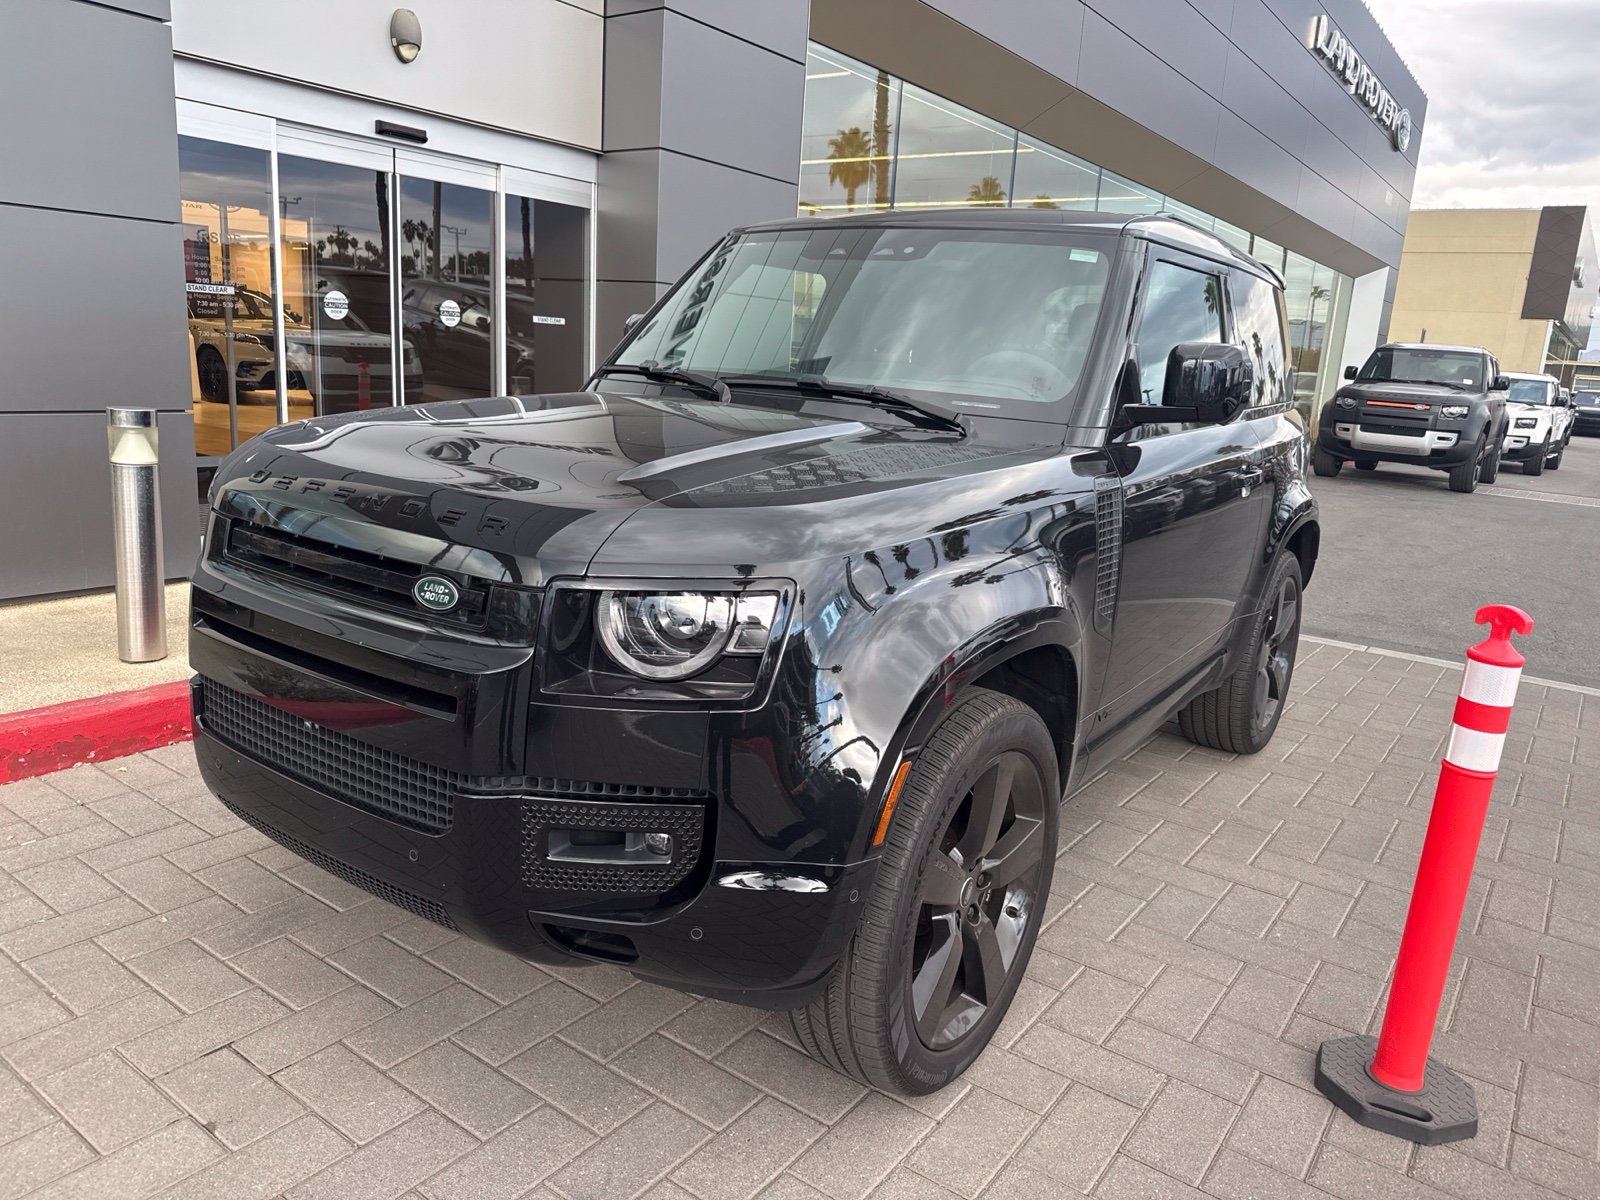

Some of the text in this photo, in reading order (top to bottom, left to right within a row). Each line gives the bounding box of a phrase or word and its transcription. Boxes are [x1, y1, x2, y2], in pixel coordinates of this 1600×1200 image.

[1308, 15, 1401, 130] LAND ROVER
[187, 284, 207, 292] STAND
[249, 469, 511, 537] DEFENDER
